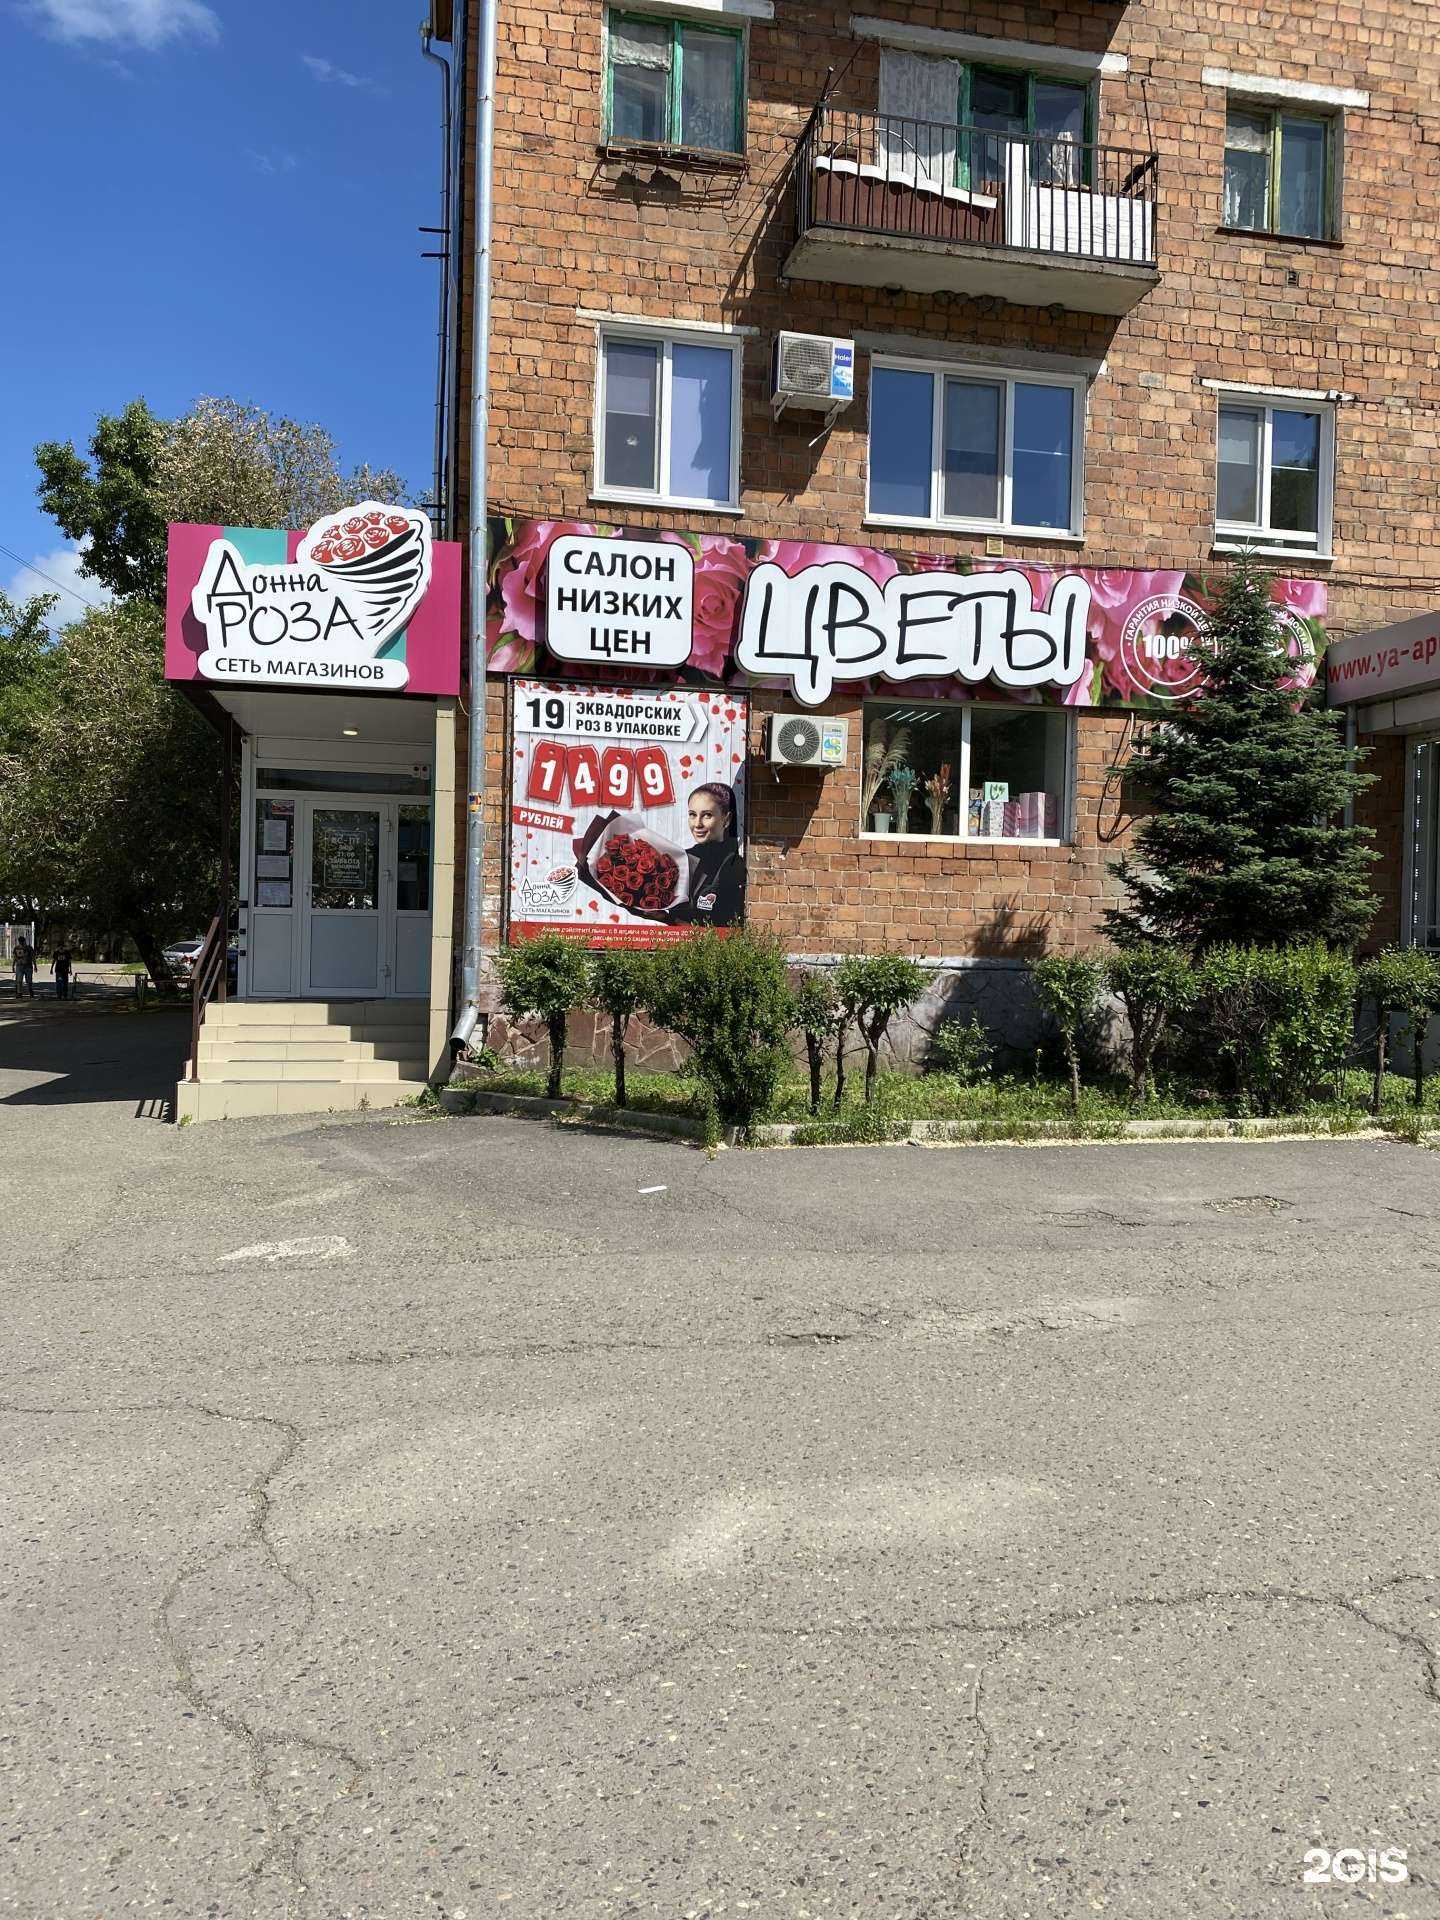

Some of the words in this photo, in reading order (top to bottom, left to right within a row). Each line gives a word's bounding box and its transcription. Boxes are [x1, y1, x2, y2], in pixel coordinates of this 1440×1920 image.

[207, 550, 328, 613] Донна
[563, 549, 675, 582] САЛОН
[557, 587, 683, 620] НИЗКИХ
[1125, 600, 1160, 641] ГАРАНТИЯ
[1160, 598, 1199, 618] НИЗКОЙ
[215, 596, 364, 647] РОЗА
[754, 581, 1076, 689] ЦВЕТЫ
[590, 627, 651, 657] ЦЕН
[215, 656, 262, 674] СЕТЬ
[267, 660, 384, 680] МАГАЗИНОВ
[1328, 636, 1440, 683] www.ya-ap
[526, 698, 565, 730] 19
[576, 701, 682, 721] ЭКВАДОРСКИХ
[576, 719, 601, 732] РОЗ
[604, 721, 612, 732] В
[616, 722, 681, 737] УПАКОВКЕ
[520, 810, 564, 829] РУБЛЕЙ
